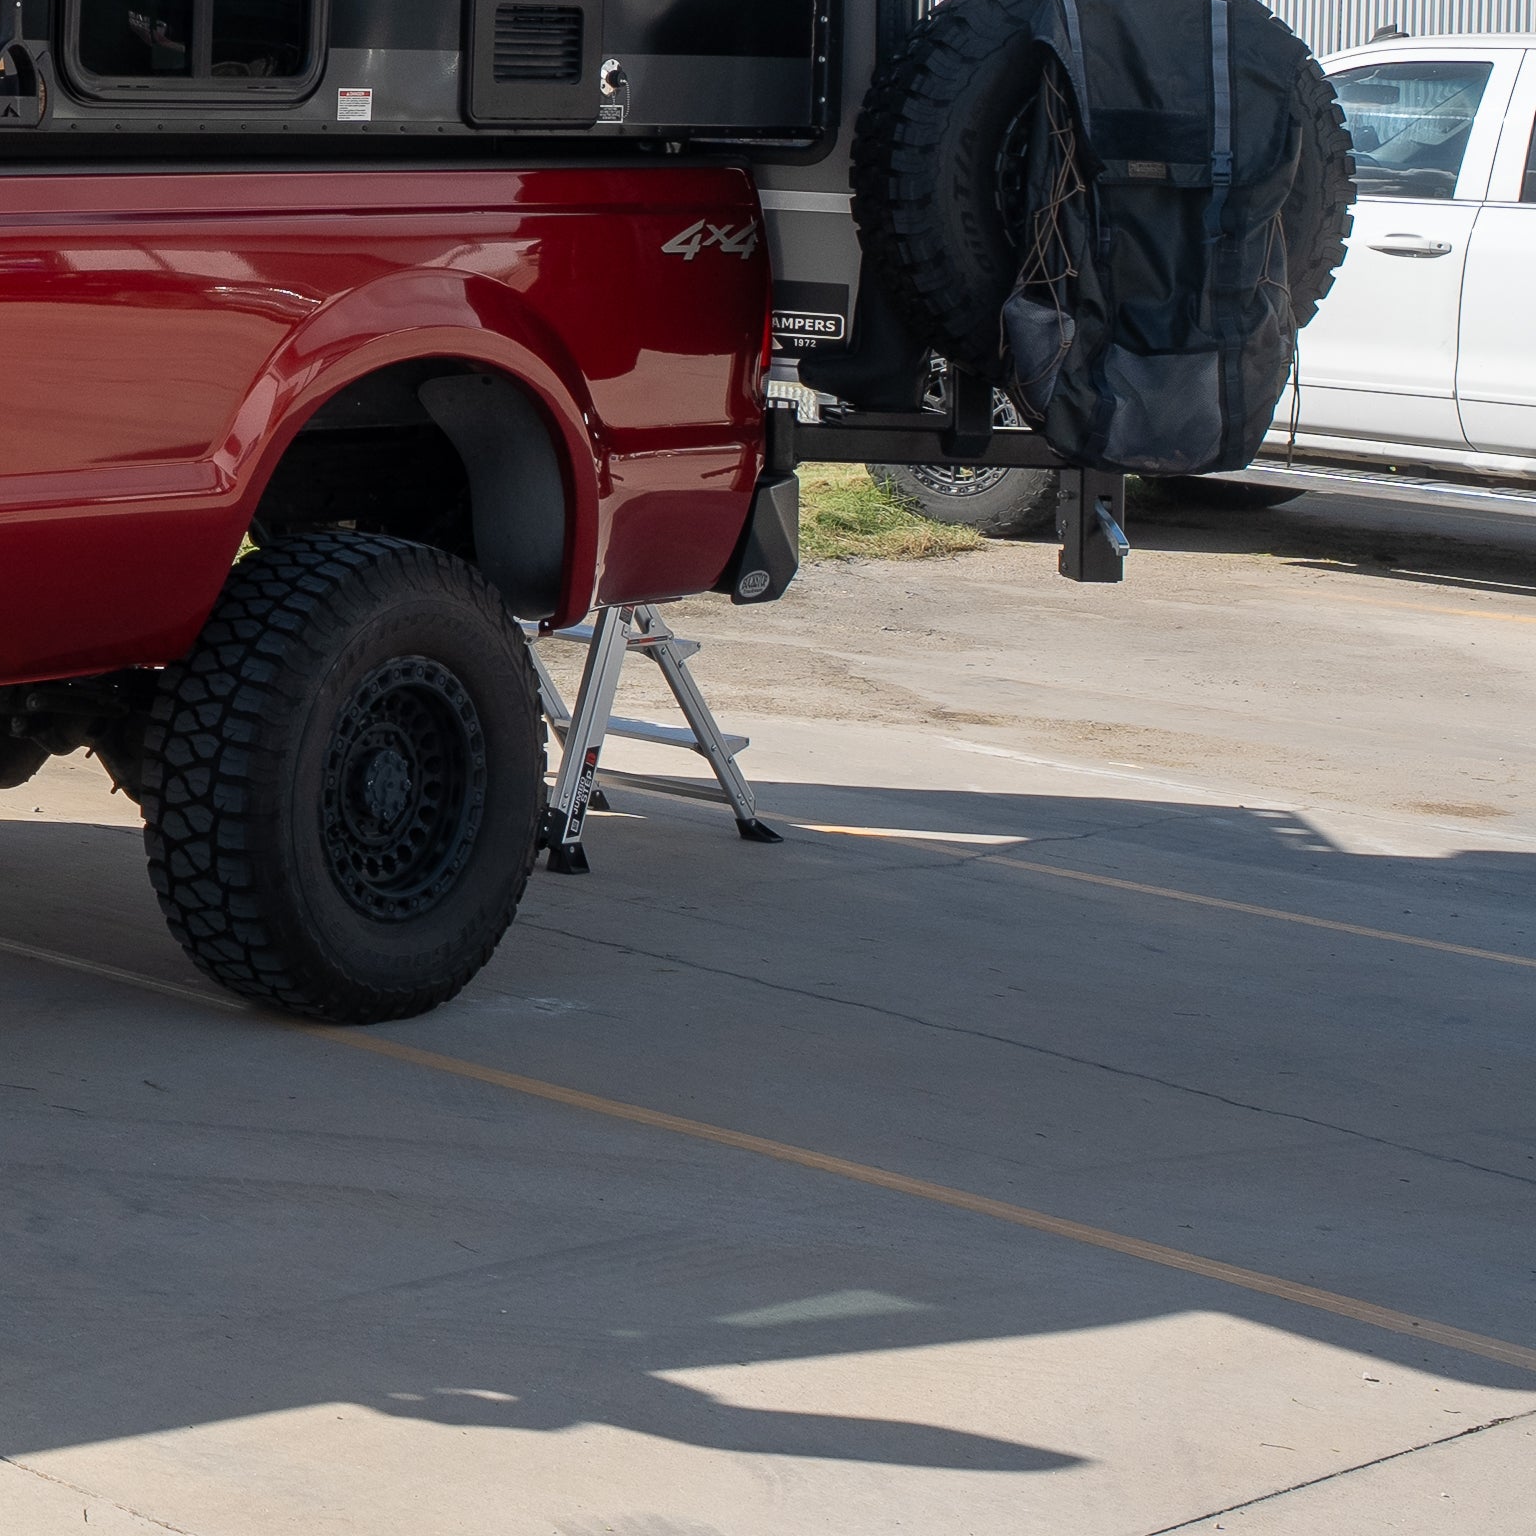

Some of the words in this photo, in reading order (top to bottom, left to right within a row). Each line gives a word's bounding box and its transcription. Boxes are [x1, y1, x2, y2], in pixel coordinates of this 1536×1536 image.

[772, 316, 836, 332] AMPERS
[793, 338, 817, 348] 1972
[573, 776, 586, 815] JUMBO
[580, 770, 593, 803] STEP
